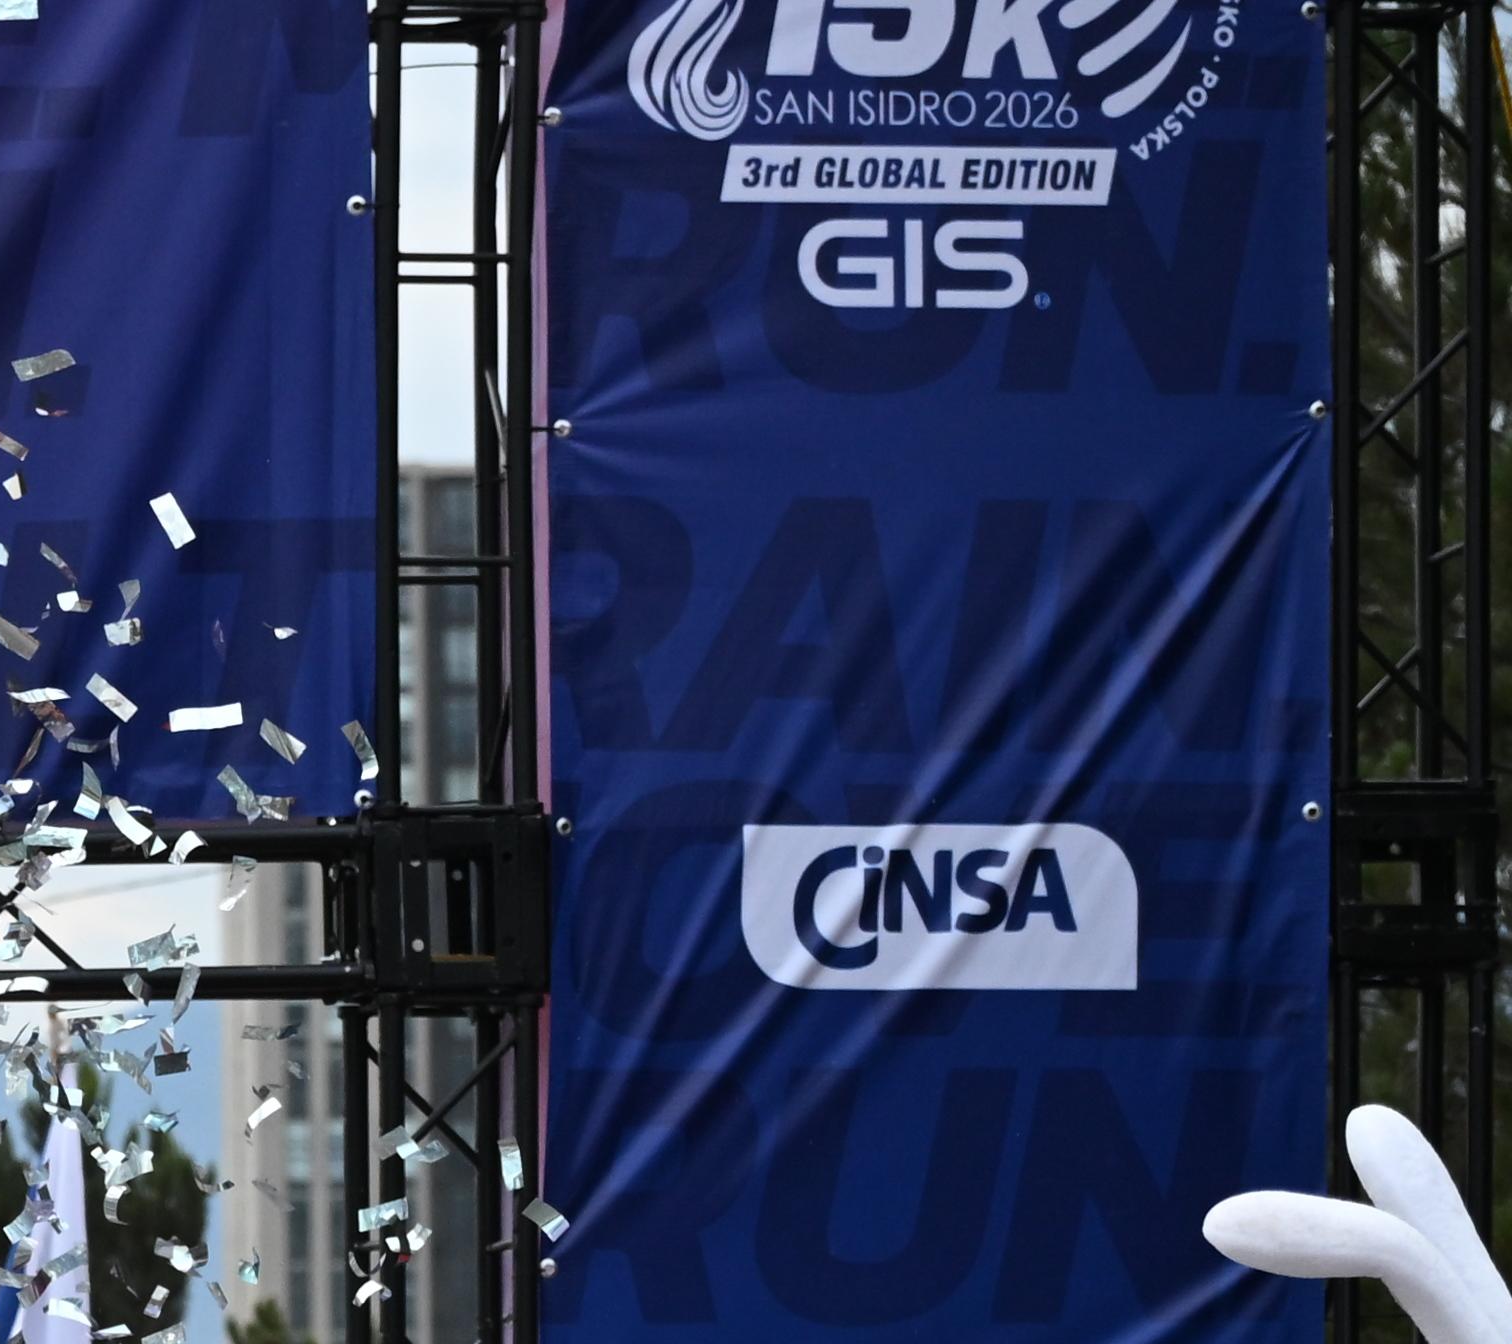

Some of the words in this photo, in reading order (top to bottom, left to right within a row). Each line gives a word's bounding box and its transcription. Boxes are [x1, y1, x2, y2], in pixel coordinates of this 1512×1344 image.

[754, 88, 834, 126] SAN
[849, 90, 977, 128] ISIDRO
[984, 90, 1079, 129] 2026
[1129, 66, 1220, 161] POLSKA
[742, 156, 800, 188] 3rd
[814, 157, 946, 190] GLOBAL
[960, 158, 1097, 192] EDITION
[797, 218, 1029, 309] GIS
